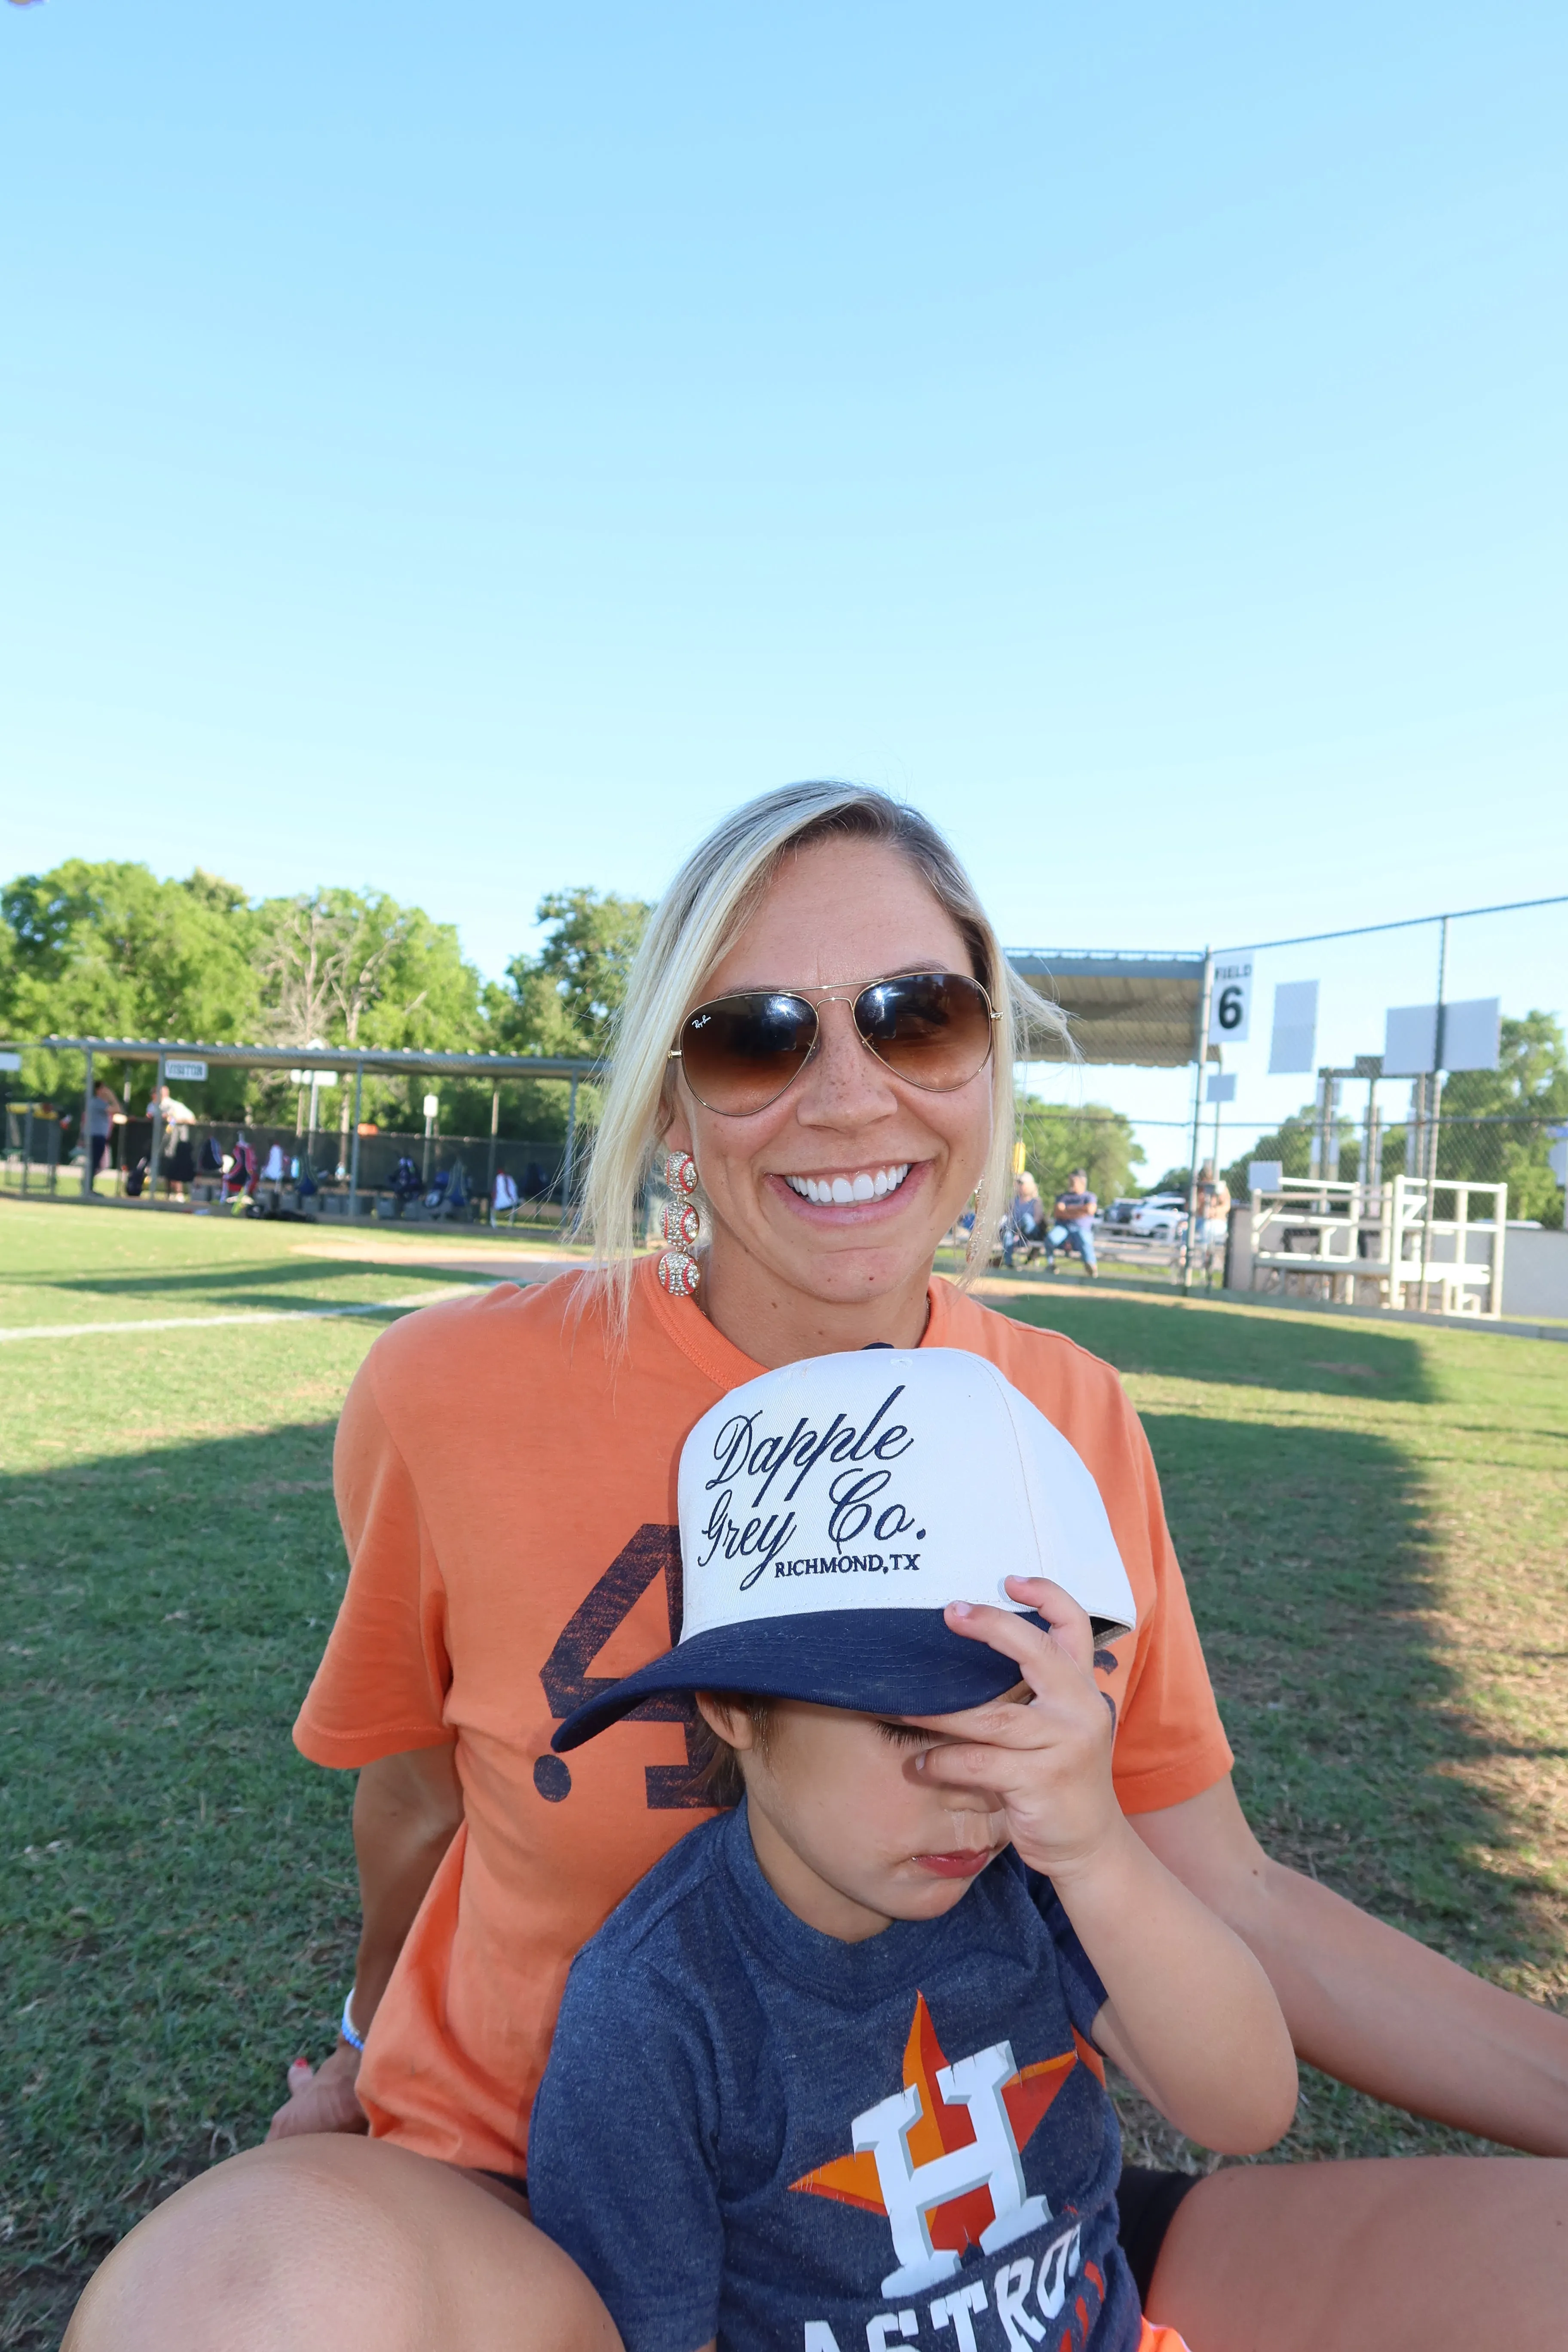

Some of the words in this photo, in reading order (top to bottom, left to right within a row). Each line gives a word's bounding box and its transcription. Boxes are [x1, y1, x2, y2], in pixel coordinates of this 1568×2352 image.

[1214, 964, 1252, 980] FIELD
[1219, 986, 1243, 1029] 6
[705, 1385, 914, 1508] Dapple
[698, 1489, 797, 1591] Grey
[828, 1467, 926, 1555] Co.
